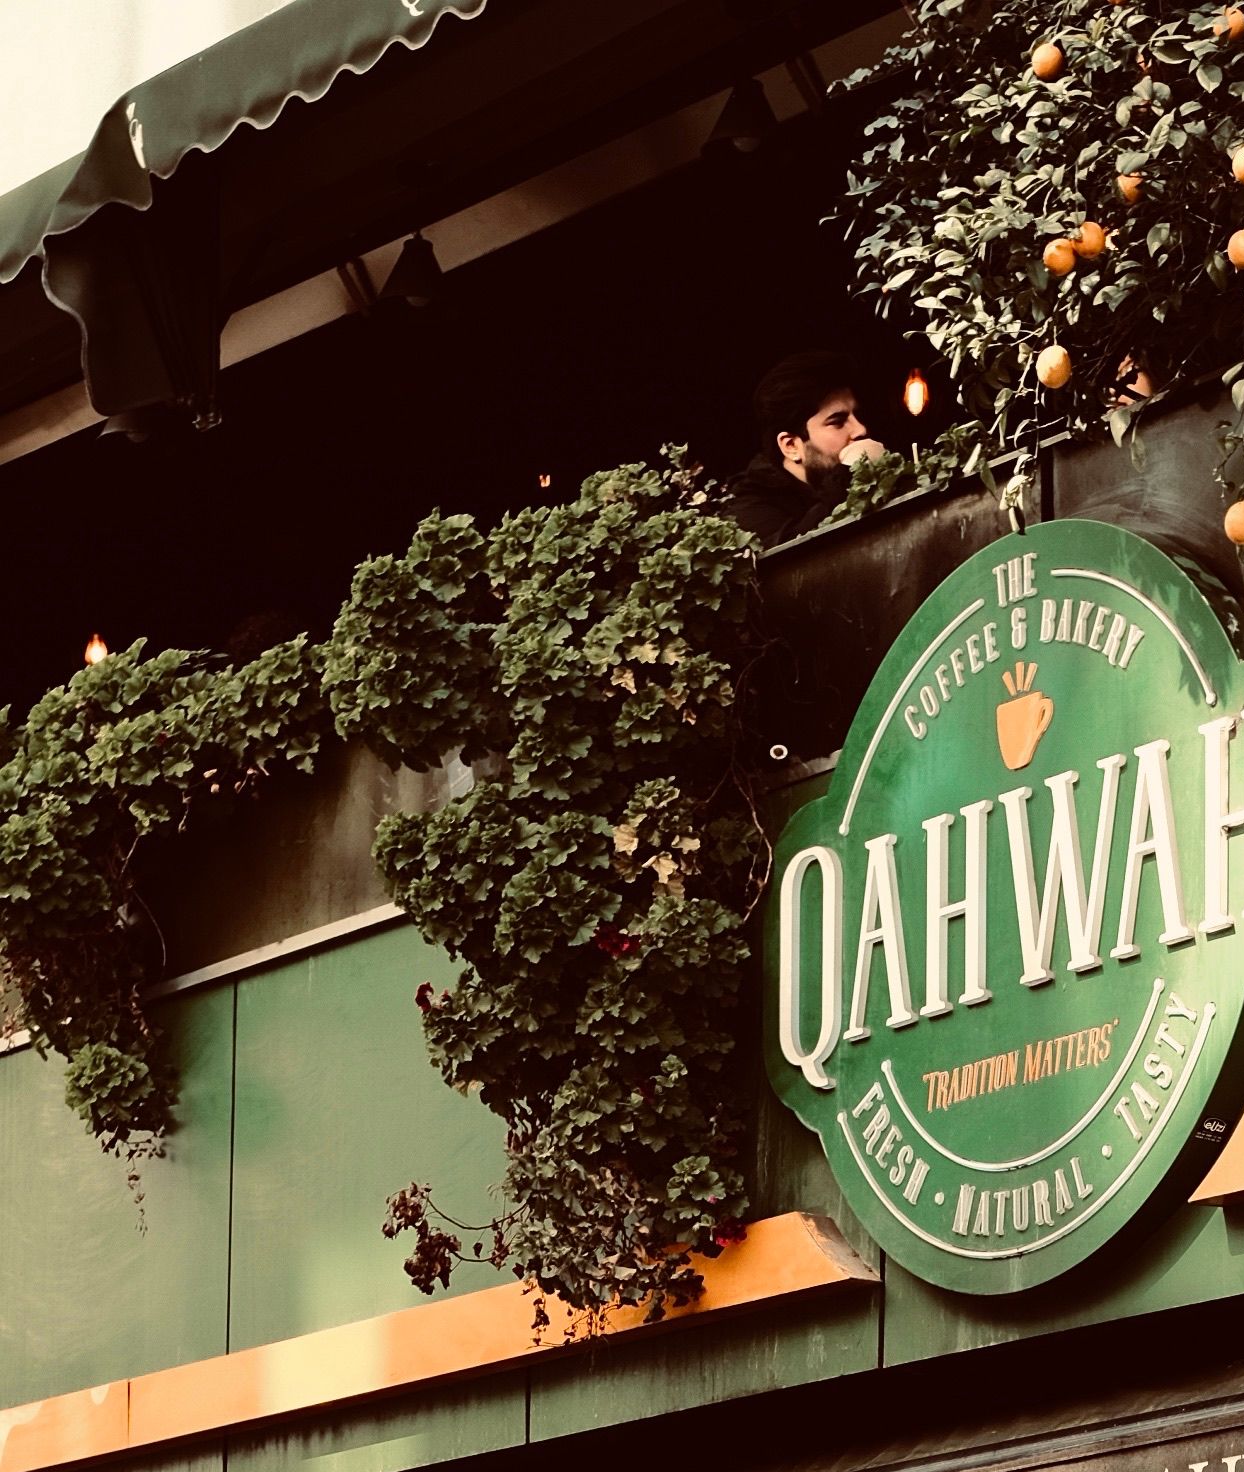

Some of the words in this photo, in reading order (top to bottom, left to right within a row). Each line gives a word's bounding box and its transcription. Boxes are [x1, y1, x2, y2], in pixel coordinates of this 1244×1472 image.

[992, 553, 1038, 608] THE
[903, 622, 1001, 741] COFFEE
[1010, 606, 1028, 650] &
[1038, 598, 1146, 671] BAKERY
[850, 1081, 930, 1206] FRESH
[951, 1159, 1093, 1236] NATURAL
[1114, 991, 1200, 1142] TASTY
